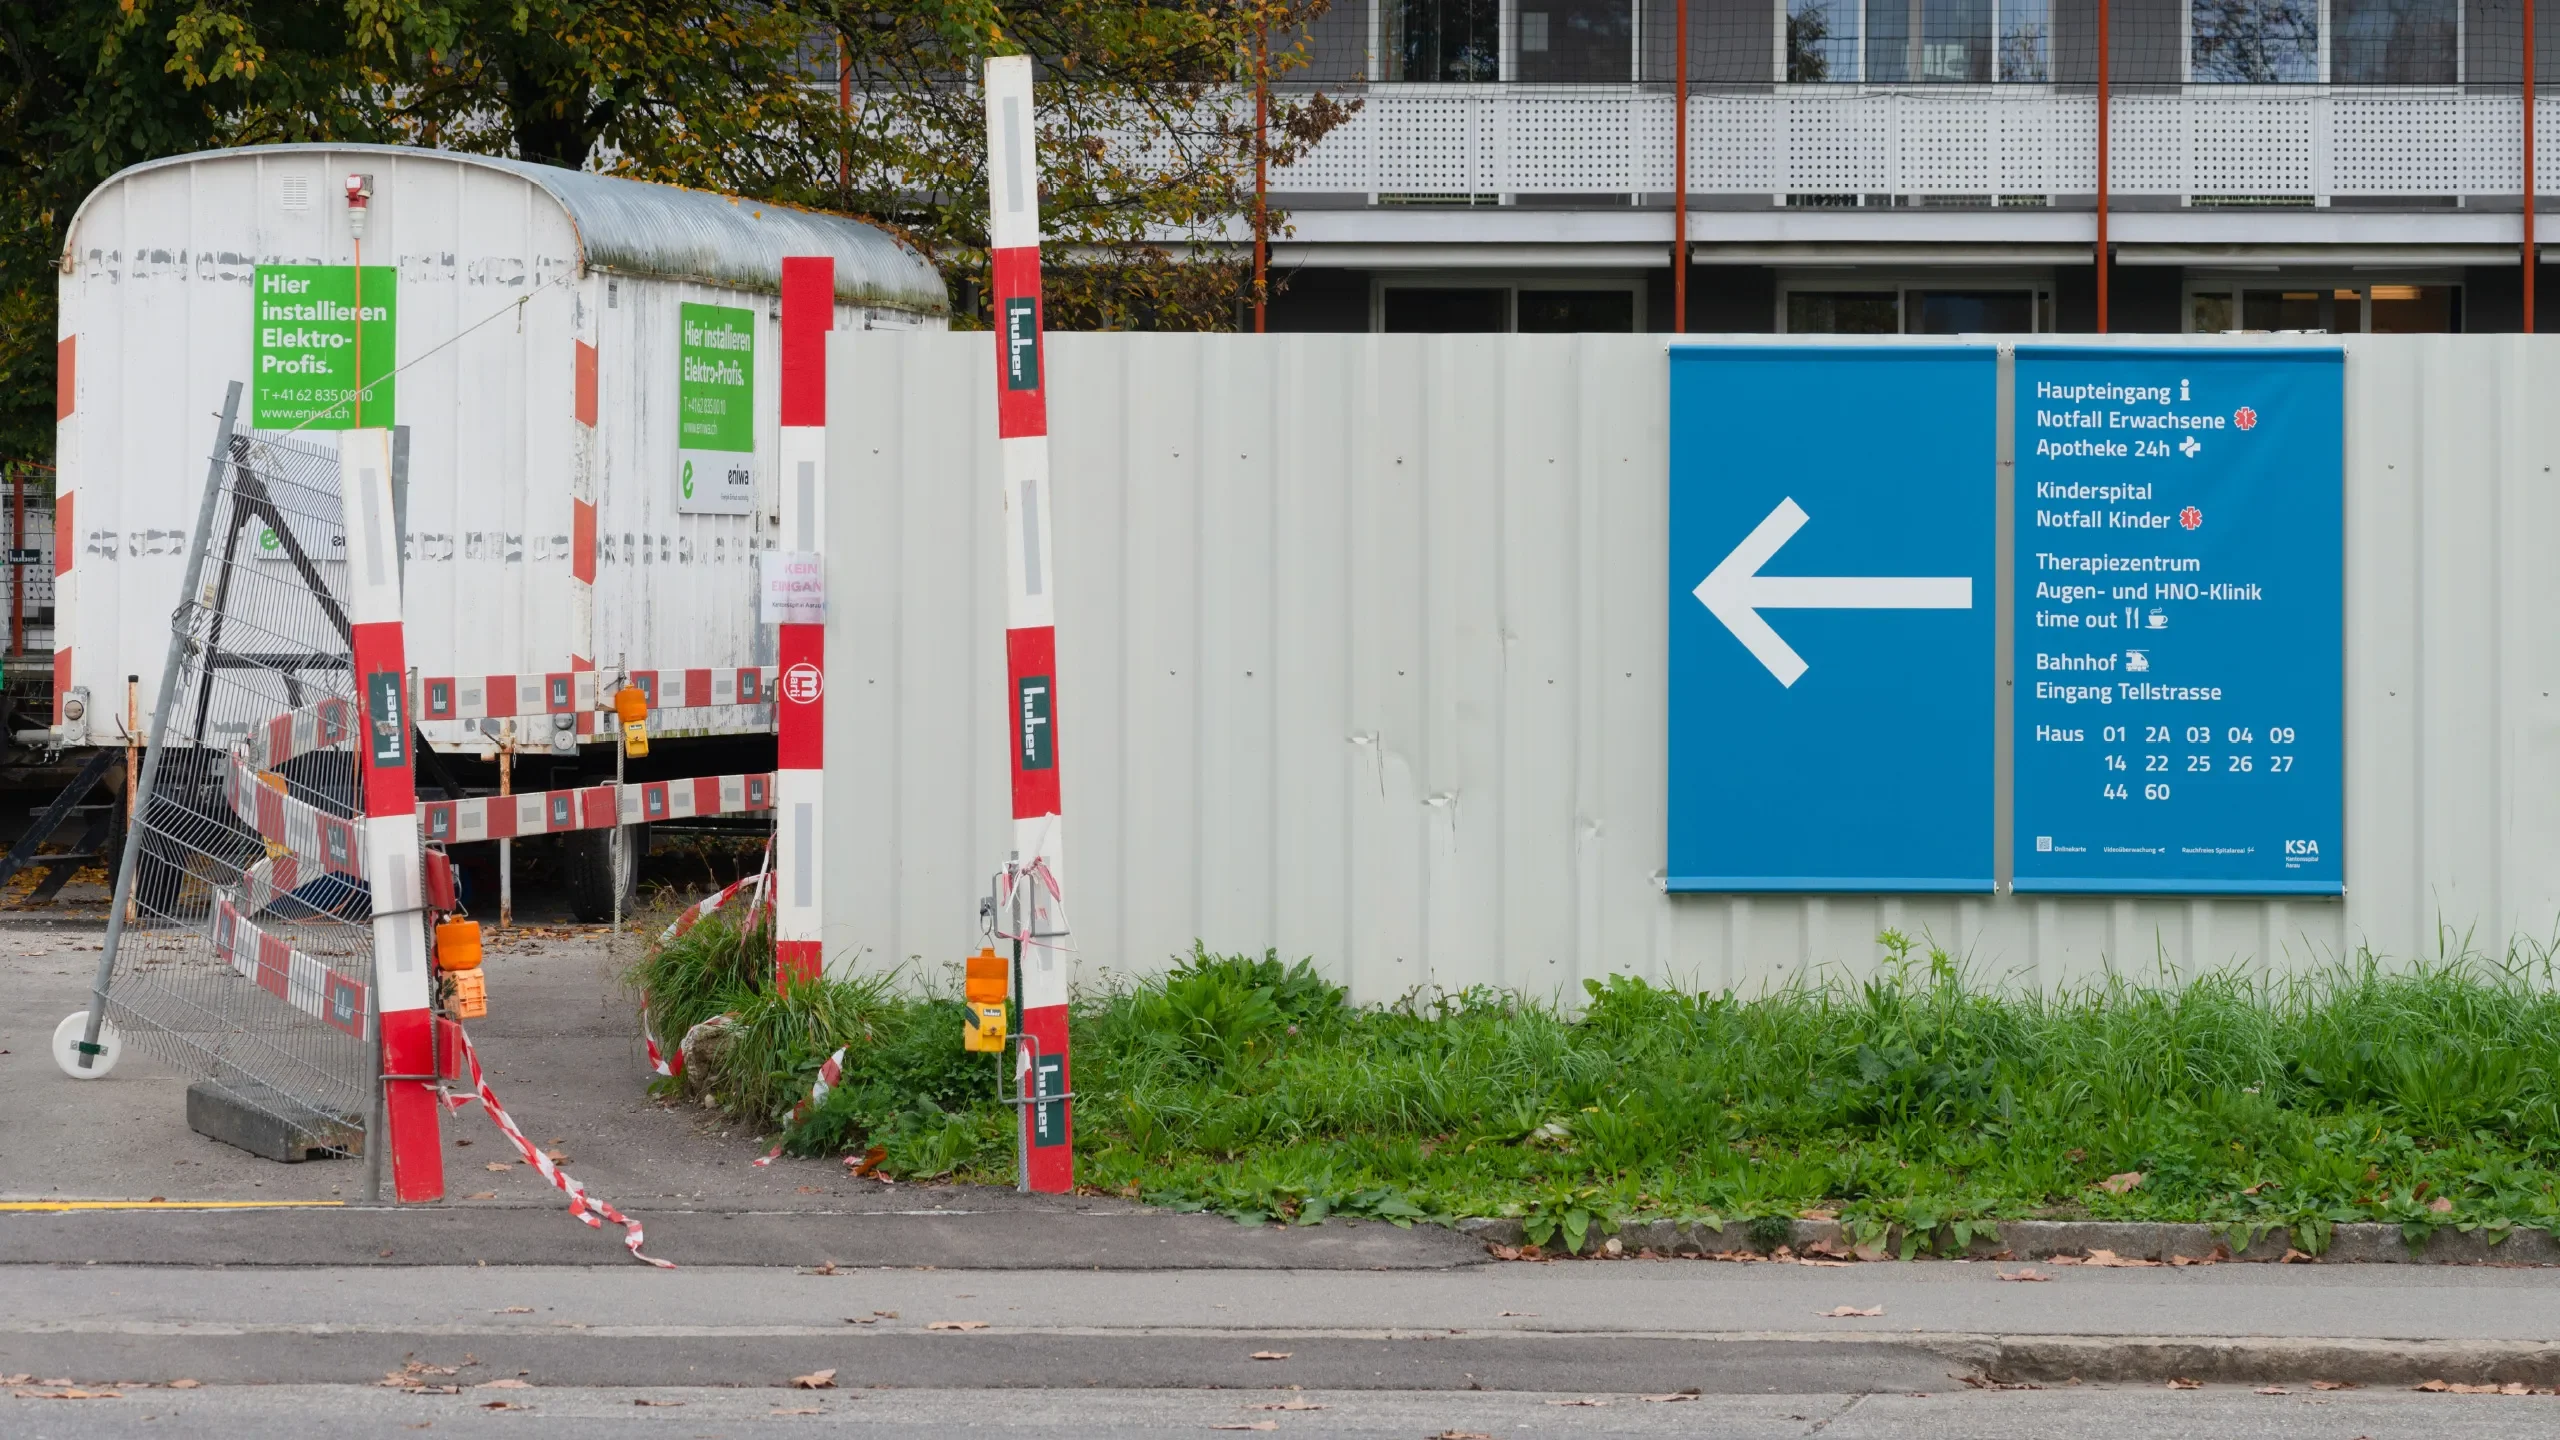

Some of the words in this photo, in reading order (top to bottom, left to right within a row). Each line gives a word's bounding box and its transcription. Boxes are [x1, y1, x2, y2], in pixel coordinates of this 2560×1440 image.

[263, 273, 311, 294] Hier
[262, 300, 387, 321] installieren
[262, 327, 352, 348] Elektro-
[684, 319, 703, 347] Hier
[704, 320, 751, 352] installieren
[1010, 308, 1033, 382] huber
[262, 354, 333, 374] Profis.
[261, 388, 270, 401] T
[272, 388, 293, 401] +41
[296, 389, 312, 401] 62
[314, 389, 338, 402] 835
[2037, 381, 2171, 405] Haupteingang
[261, 407, 350, 419] www.eniwa.ch
[2037, 409, 2102, 428] Notfall
[2109, 411, 2226, 430] Erwachsene
[2036, 438, 2128, 461] Apotheke
[2134, 439, 2170, 457] 24h
[728, 463, 749, 485] eniwa
[2037, 481, 2152, 504] Kinderspital
[2037, 509, 2102, 528] Notfall
[2109, 511, 2171, 529] Kinder
[784, 563, 818, 574] KEIN
[2035, 552, 2201, 576] Therapiezentrum
[2035, 581, 2105, 604] Augen-
[2112, 582, 2148, 600] und
[2155, 583, 2262, 601] HNO-Klinik
[2035, 610, 2080, 628] time
[2085, 612, 2118, 628] out
[2036, 652, 2118, 671] Bahnhof
[2036, 681, 2113, 705] Eingang
[2117, 682, 2222, 701] Tellstrasse
[1023, 686, 1047, 762] huber
[2036, 724, 2085, 742] Haus
[2103, 725, 2125, 742] 01
[2145, 725, 2171, 742] 2A
[2186, 726, 2211, 744] 03
[2227, 727, 2254, 744] 04
[2269, 727, 2295, 744] 09
[2104, 754, 2127, 771] 14
[2145, 755, 2169, 772] 22
[2187, 755, 2211, 772] 25
[2228, 755, 2253, 773] 26
[2270, 755, 2294, 773] 27
[2103, 783, 2128, 800] 44
[2144, 783, 2170, 801] 60
[2285, 839, 2319, 855] KSA
